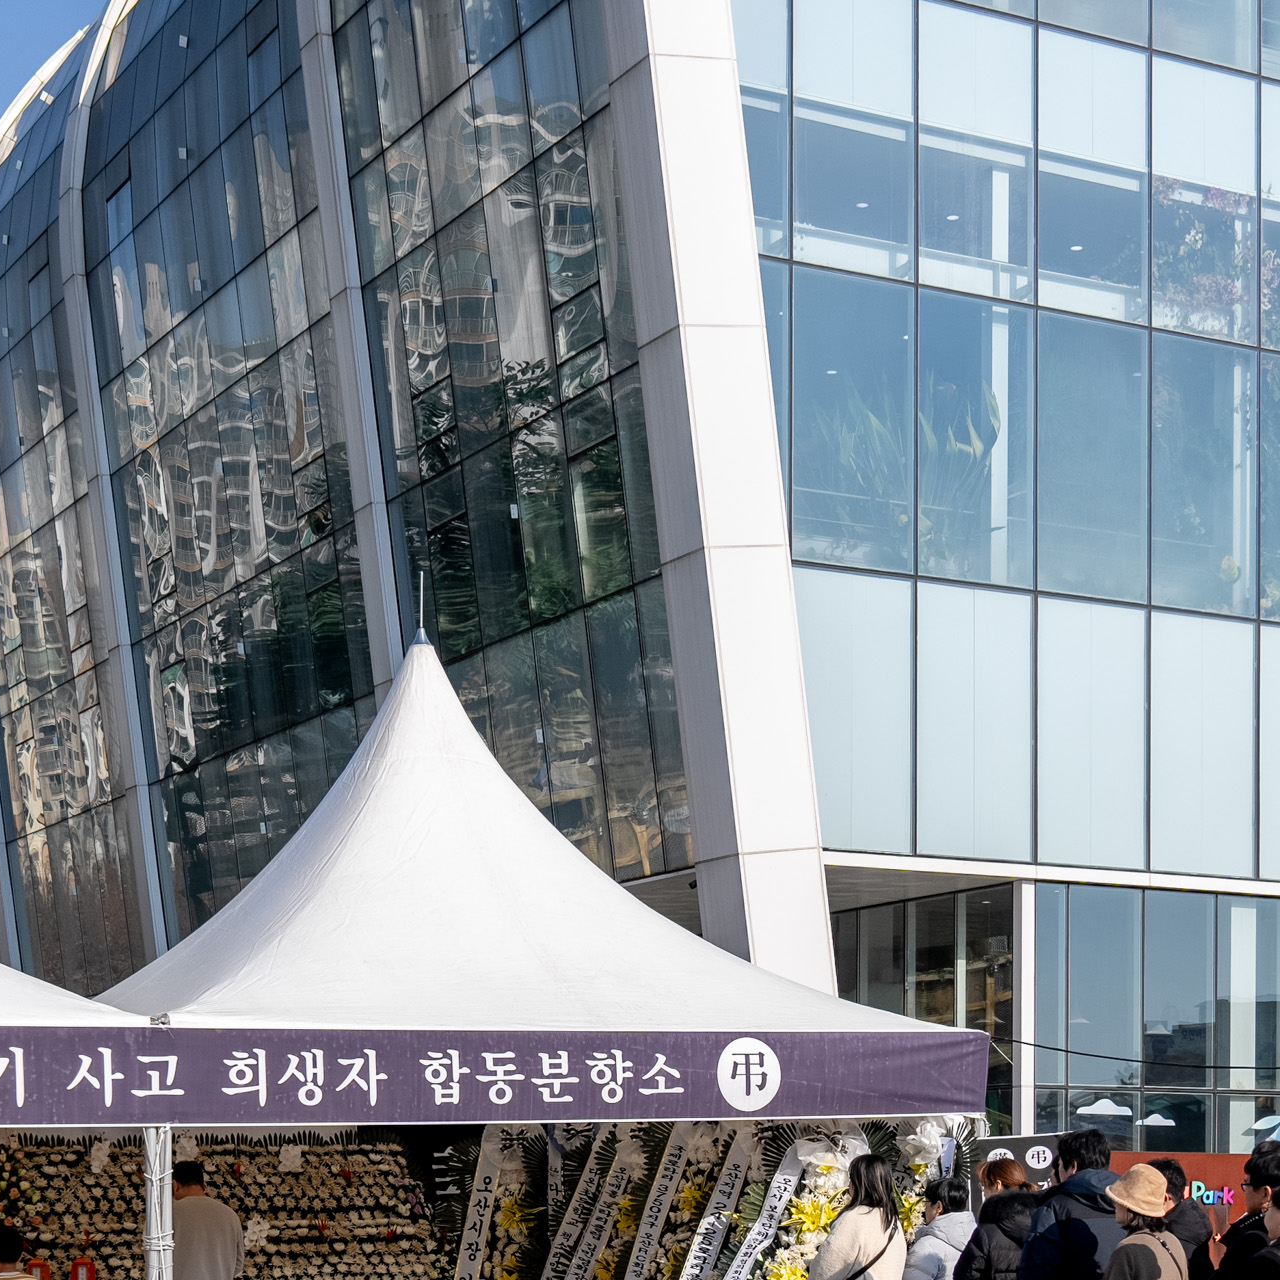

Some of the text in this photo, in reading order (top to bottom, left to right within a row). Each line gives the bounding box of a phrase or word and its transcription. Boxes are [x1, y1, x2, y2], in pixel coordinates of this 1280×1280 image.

[66, 1047, 185, 1108] 사고
[223, 1047, 388, 1107] 희생자
[423, 1049, 686, 1104] 합동분향소
[730, 1051, 770, 1097] 弔
[660, 1144, 686, 1182] 국제로타리
[1031, 1149, 1047, 1164] 弔
[720, 1163, 742, 1200] 오산지역
[770, 1178, 793, 1202] 오산시
[465, 1175, 493, 1262] 오산시장
[642, 1184, 669, 1229] 3750지구
